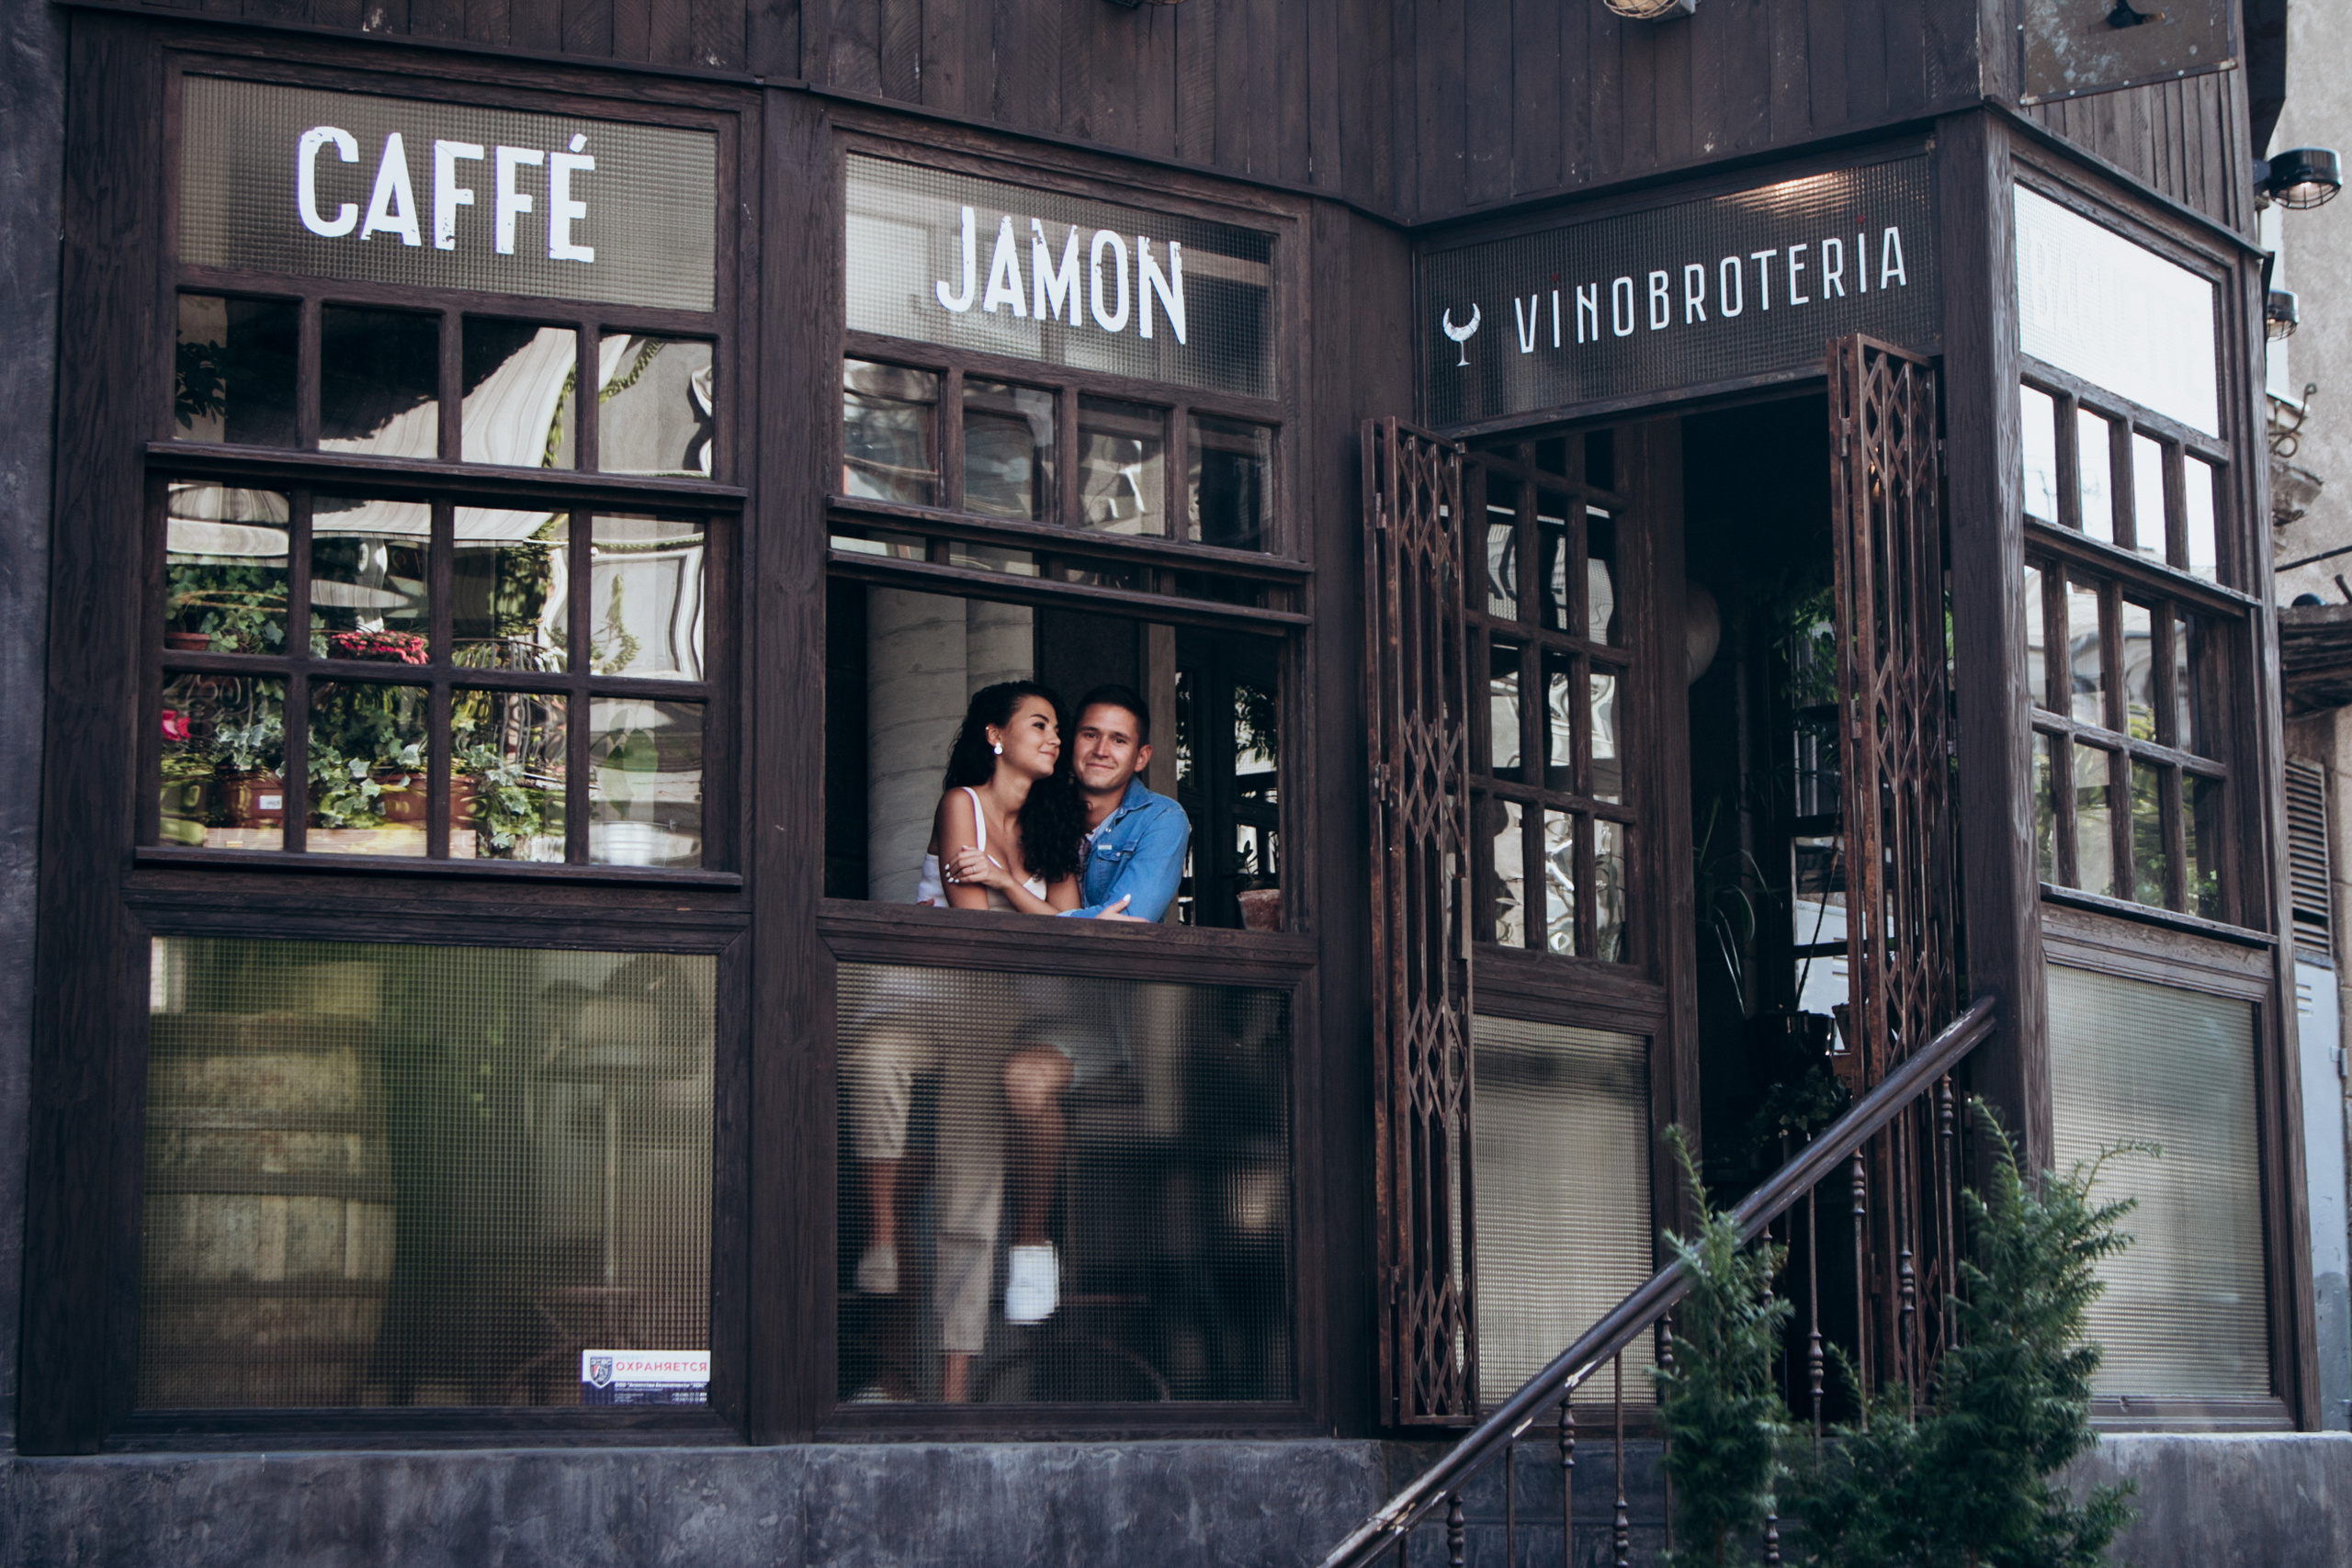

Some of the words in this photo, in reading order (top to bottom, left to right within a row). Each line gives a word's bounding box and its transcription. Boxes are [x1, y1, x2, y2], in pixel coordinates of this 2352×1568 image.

[299, 125, 595, 263] CAFFÉ
[935, 205, 1187, 345] JAMON
[1514, 225, 1907, 354] VINOBROTERIA
[616, 1361, 707, 1371] ОХРАНЯЕТСЯ
